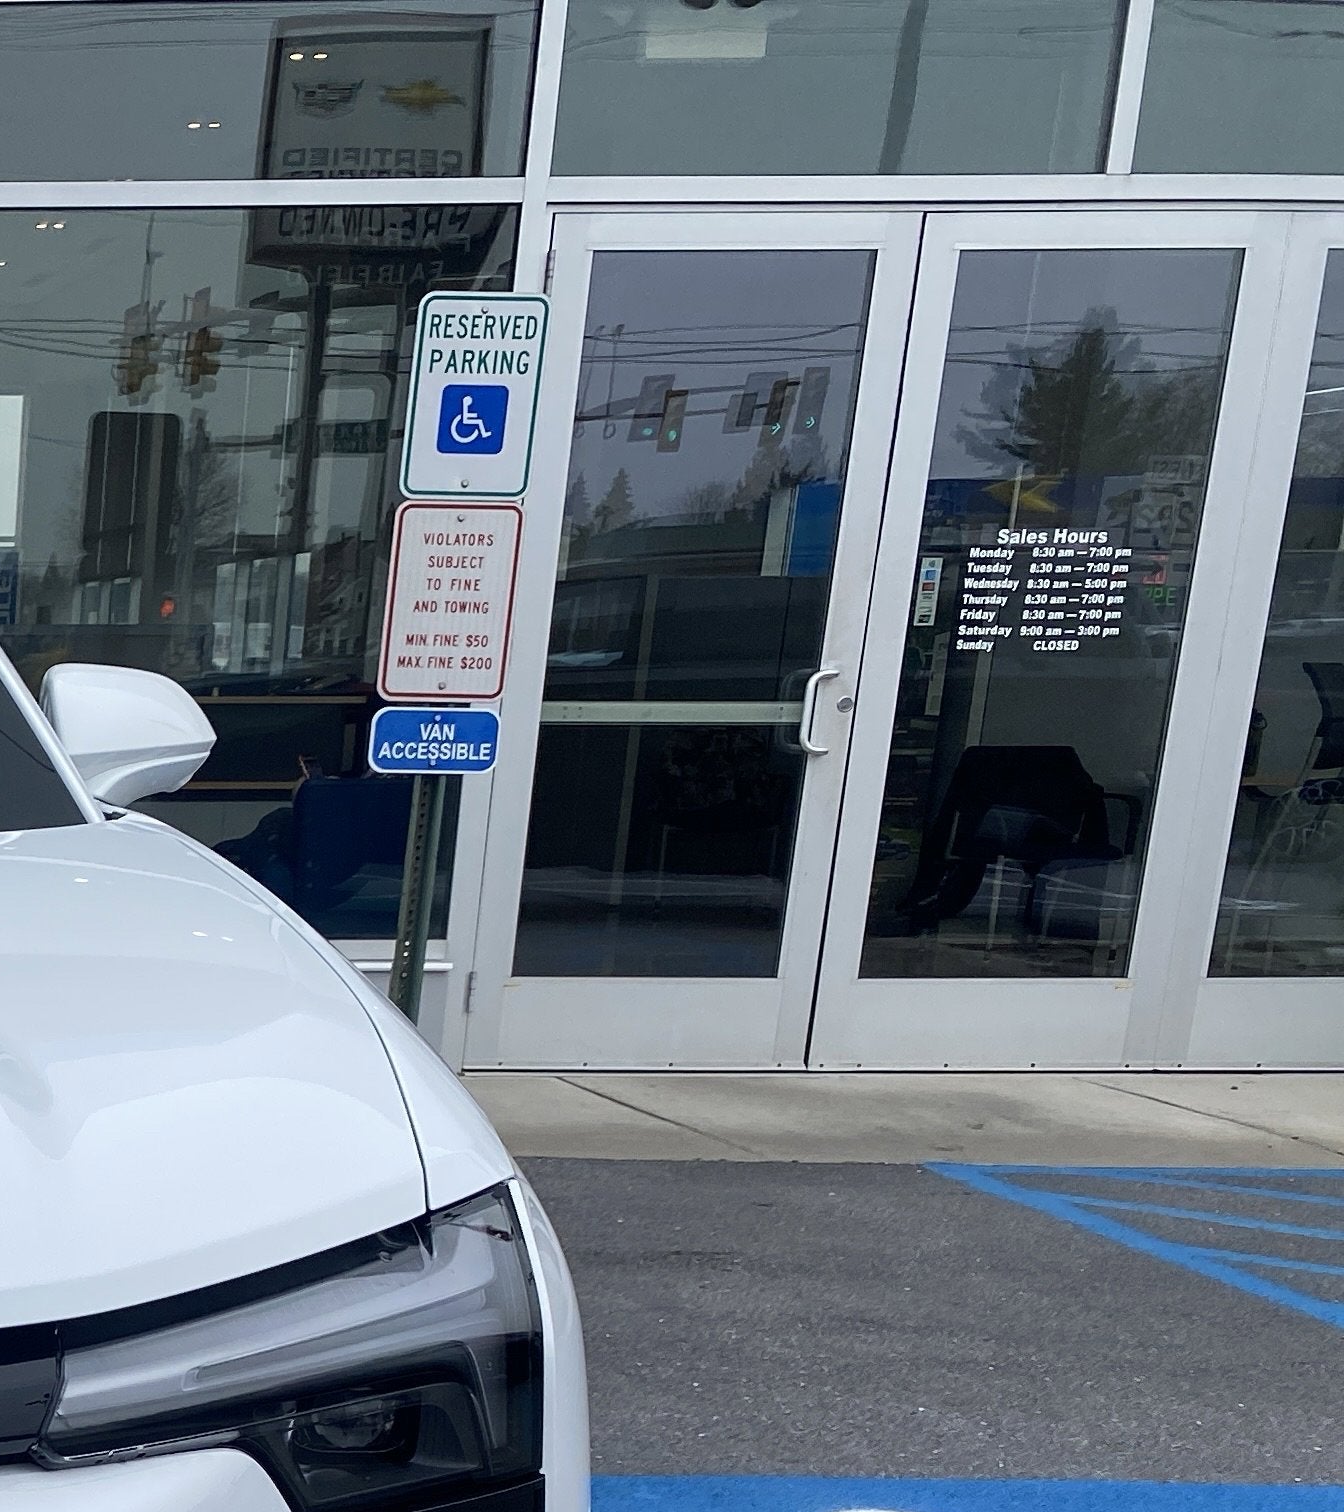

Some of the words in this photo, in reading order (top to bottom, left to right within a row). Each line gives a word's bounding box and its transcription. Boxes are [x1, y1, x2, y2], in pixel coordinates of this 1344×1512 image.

[429, 313, 539, 340] RESERVED
[429, 350, 530, 375] PARKING
[423, 533, 495, 547] VIOLATORS
[997, 528, 1048, 545] Sales
[1054, 528, 1108, 544] Hours
[969, 547, 1015, 559] Monday
[1032, 546, 1056, 558] 8:30
[1058, 549, 1075, 558] am
[1089, 546, 1114, 558] 7:00
[1115, 548, 1132, 560] pm
[427, 556, 485, 569] SUBJECT
[967, 562, 1012, 575] Tuesday
[1029, 562, 1053, 573] 8:30
[1055, 564, 1072, 573] am
[1086, 562, 1110, 573] 7:00
[1111, 564, 1129, 575] pm
[426, 578, 442, 591] TO
[450, 578, 481, 591] FINE
[964, 578, 1020, 590] Wednesday
[1027, 578, 1051, 589] 8:30
[1052, 580, 1069, 589] am
[1084, 578, 1108, 589] 5:00
[1109, 580, 1127, 590] pm
[962, 594, 1008, 606] Thursday
[1024, 594, 1048, 605] 8:30
[1049, 596, 1067, 605] am
[1081, 594, 1105, 605] 7:00
[1106, 595, 1124, 606] pm
[412, 600, 438, 614] AND
[444, 600, 490, 615] TOWING
[959, 609, 996, 621] Friday
[1022, 609, 1046, 620] 8:30
[1047, 611, 1064, 620] am
[1078, 609, 1103, 620] 7:00
[1104, 611, 1122, 621] pm
[958, 625, 1013, 637] Saturday
[1020, 625, 1043, 636] 9:00
[1045, 627, 1062, 636] am
[1077, 625, 1101, 636] 3:00
[1102, 627, 1120, 638] pm
[433, 634, 459, 648] FINE
[465, 634, 489, 648] $50
[956, 639, 994, 652] Sunday
[1033, 641, 1080, 651] CLOSED
[427, 656, 454, 670] FINE
[460, 655, 493, 671] $200
[420, 722, 455, 741] VAN
[378, 742, 491, 761] ACCESSIBLE
